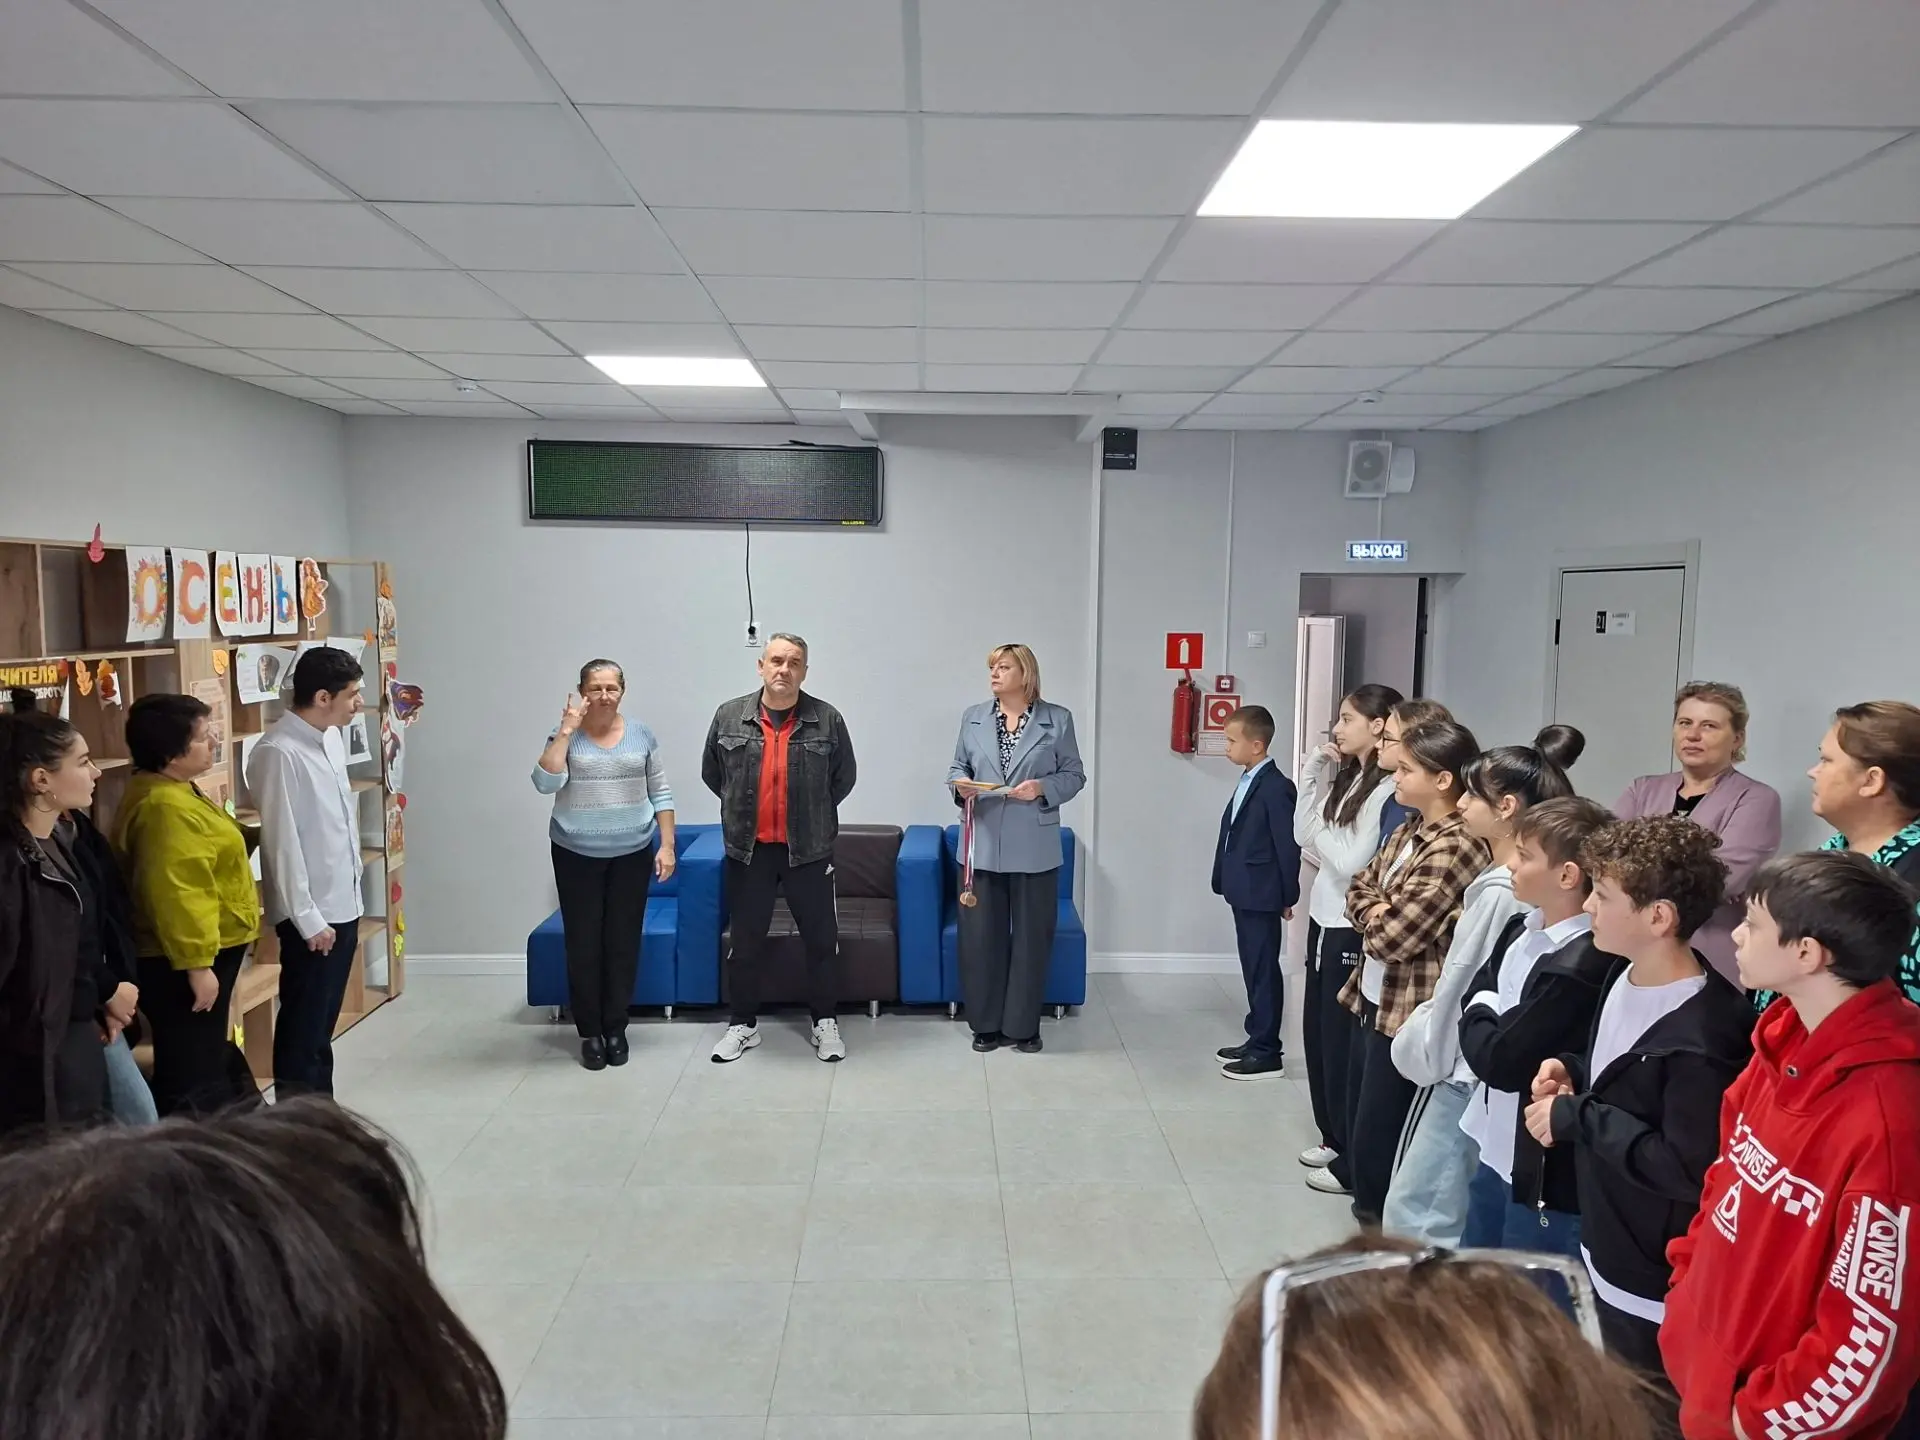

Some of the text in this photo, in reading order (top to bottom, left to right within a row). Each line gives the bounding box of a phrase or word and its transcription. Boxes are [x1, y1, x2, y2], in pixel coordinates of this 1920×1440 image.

[1352, 543, 1403, 559] ВЫХОД
[134, 559, 297, 626] ОСЕНЬ
[30, 686, 65, 700] ОБРОТУ
